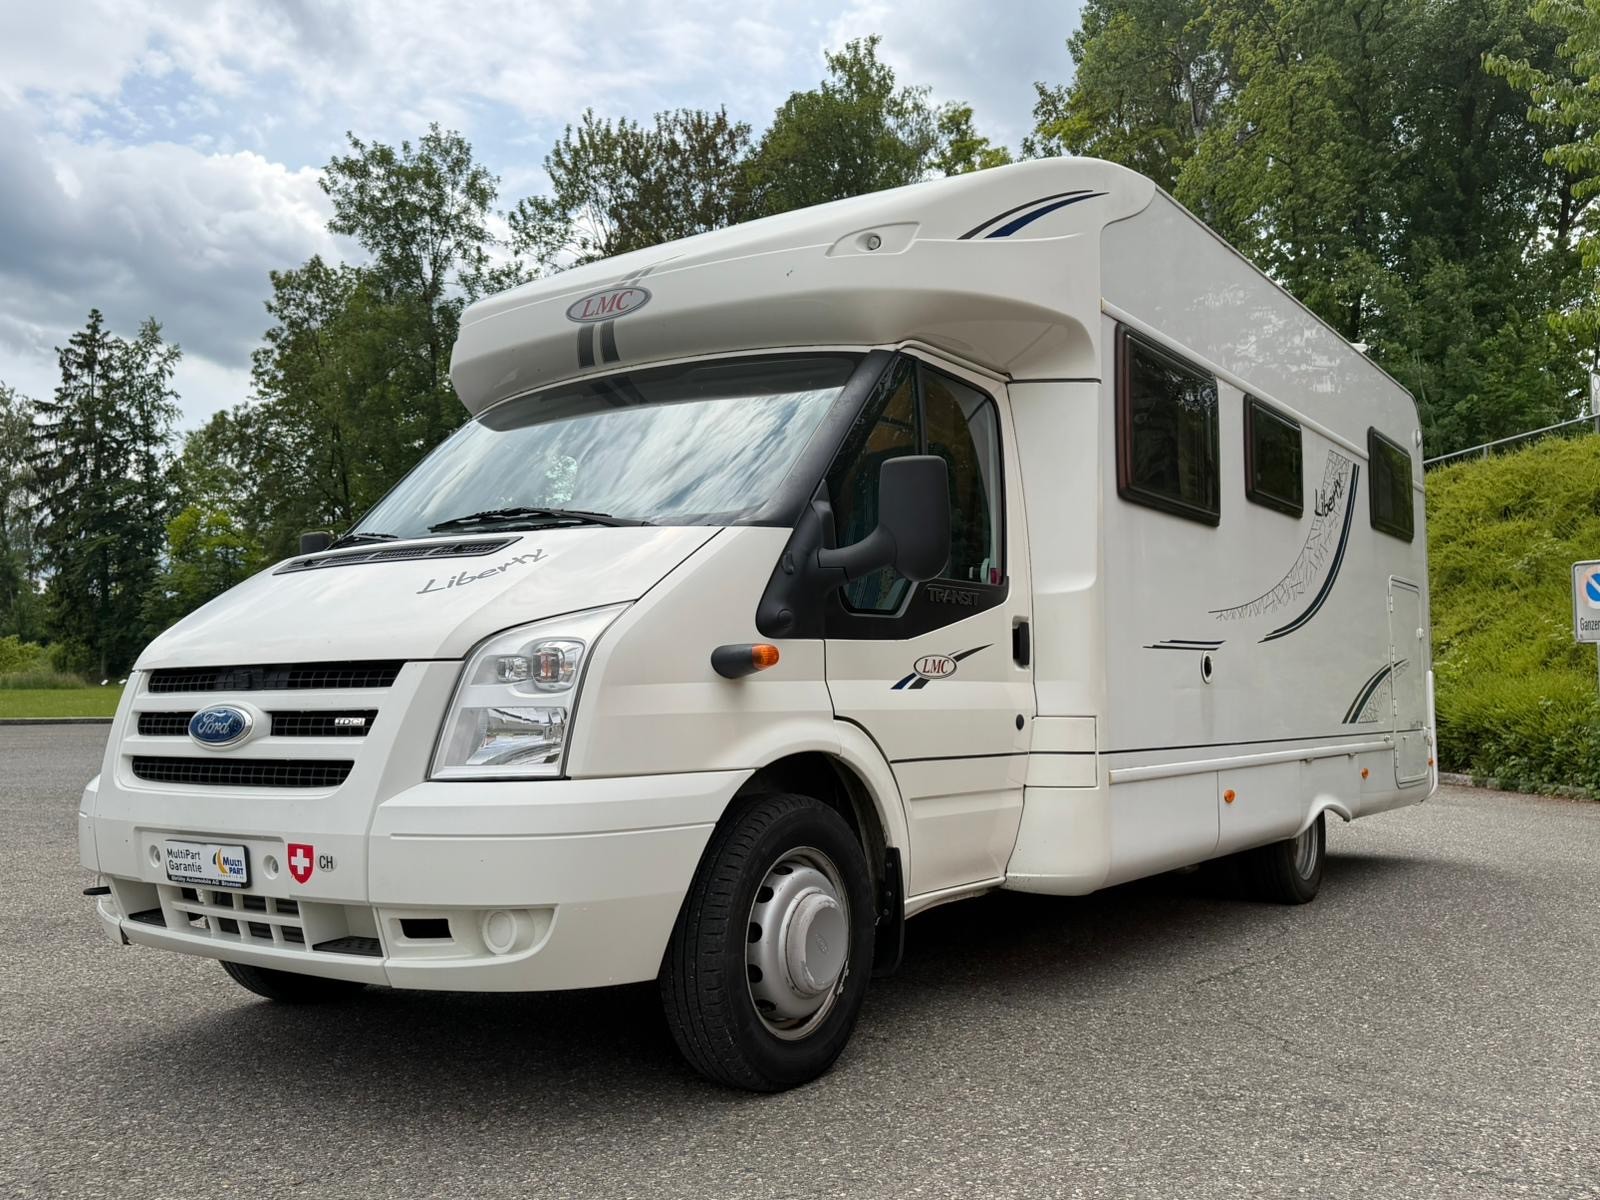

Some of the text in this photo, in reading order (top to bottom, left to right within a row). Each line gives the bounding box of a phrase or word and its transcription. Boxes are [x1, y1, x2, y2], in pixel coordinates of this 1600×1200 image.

[581, 290, 634, 319] LMC
[1314, 475, 1346, 517] Liberty
[415, 548, 549, 595] Liberty
[928, 587, 980, 606] TRANSIT
[922, 658, 949, 674] LMC
[197, 710, 232, 735] Ford
[166, 848, 201, 861] MultiPart
[319, 855, 334, 869] CH
[168, 860, 202, 873] Garantie
[228, 866, 244, 875] PART
